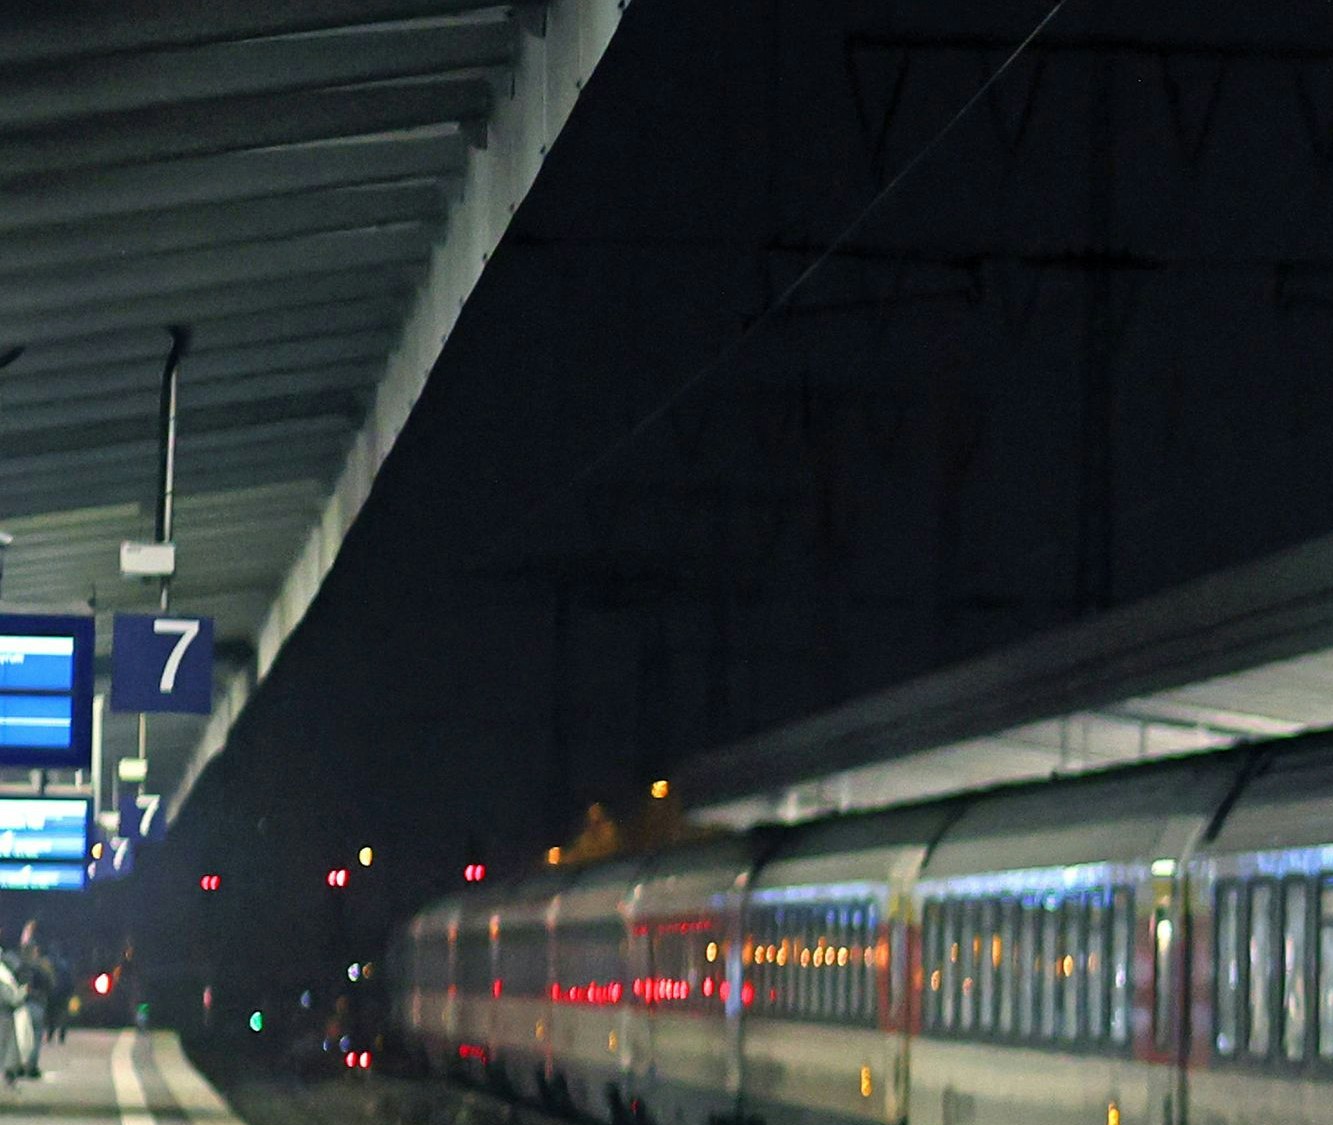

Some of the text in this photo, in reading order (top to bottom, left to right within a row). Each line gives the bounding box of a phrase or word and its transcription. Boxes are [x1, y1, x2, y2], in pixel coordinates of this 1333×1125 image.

[153, 619, 199, 693] 7
[135, 794, 160, 836] 7
[109, 836, 129, 870] 7
